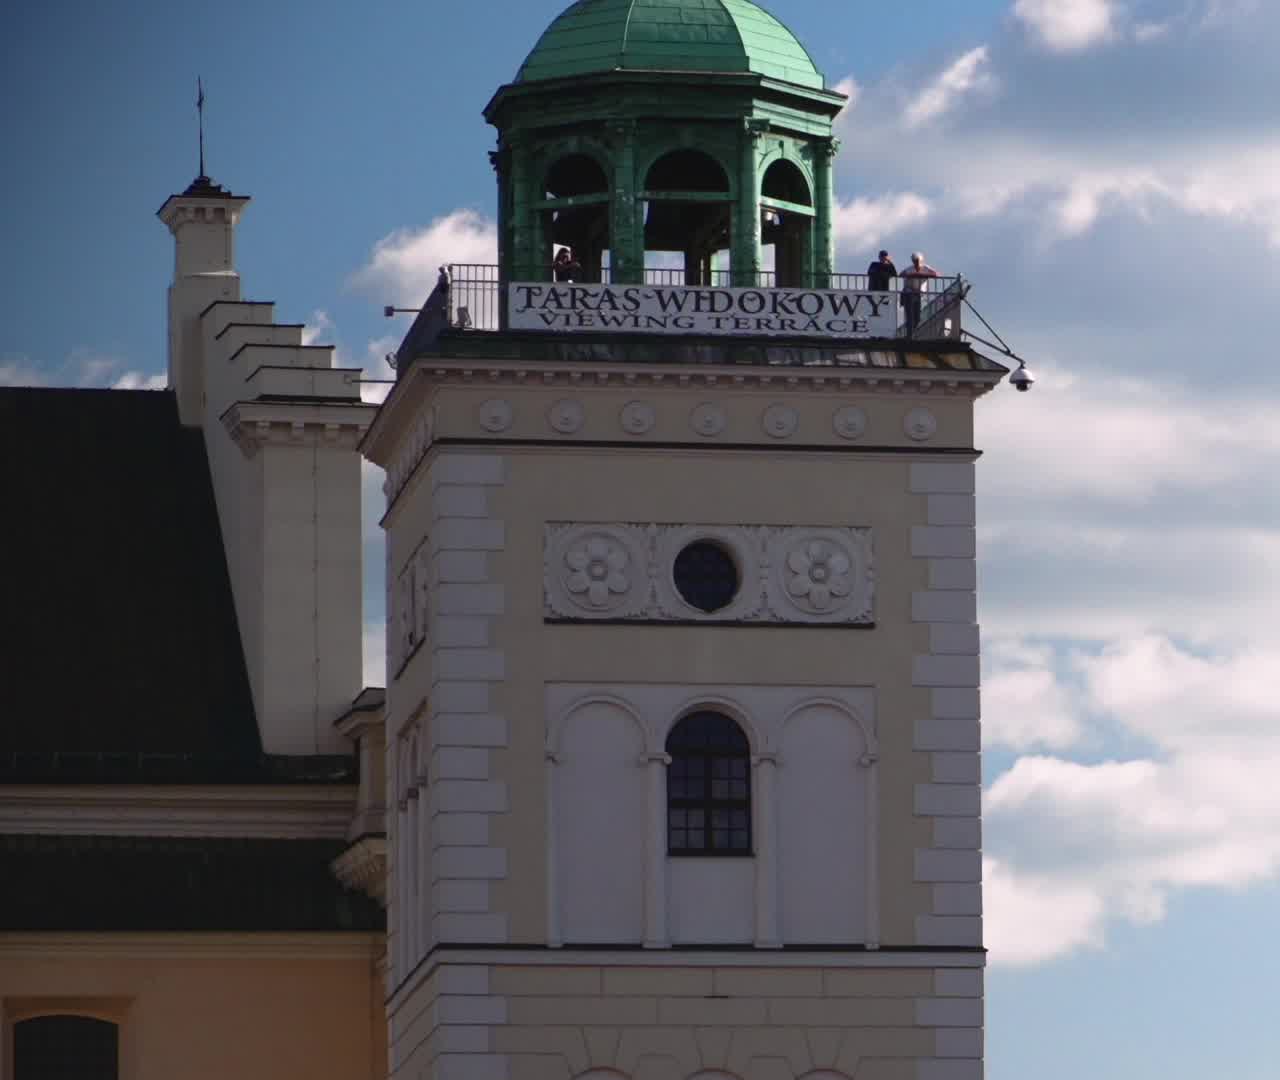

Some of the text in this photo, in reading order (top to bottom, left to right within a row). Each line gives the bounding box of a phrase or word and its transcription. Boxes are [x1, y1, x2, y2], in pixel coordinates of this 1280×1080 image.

[516, 285, 889, 318] TARAS WIDOKOWY
[538, 312, 870, 334] VIEWING TERRACE
